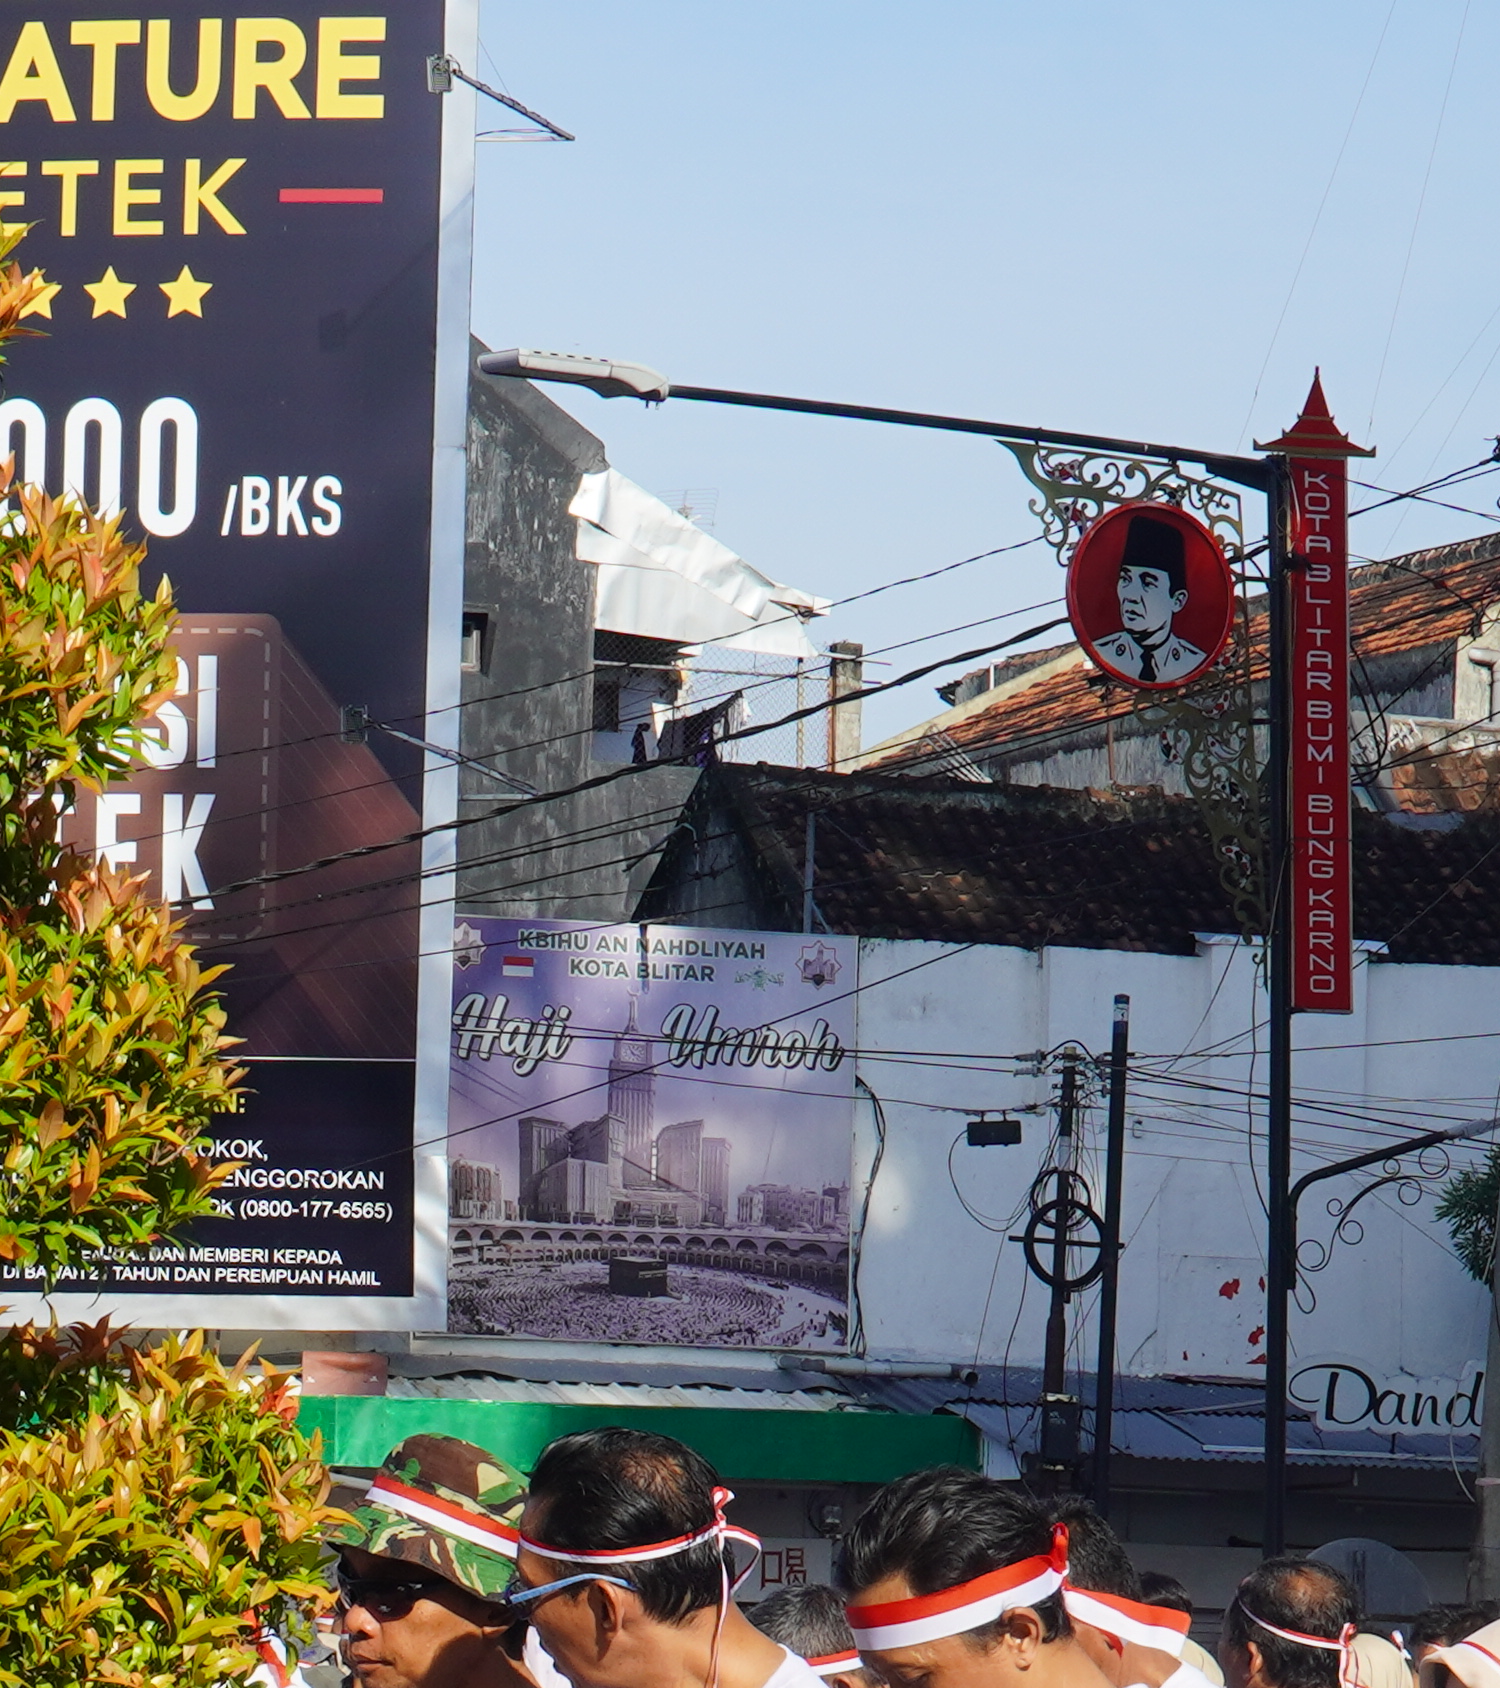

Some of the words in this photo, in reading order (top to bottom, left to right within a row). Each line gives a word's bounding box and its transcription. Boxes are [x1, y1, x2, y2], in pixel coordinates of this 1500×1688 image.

[220, 474, 343, 536] /BKS
[1304, 470, 1331, 553] KOTA
[1305, 564, 1332, 691] BLITAR
[1306, 700, 1333, 784] BUMI
[1307, 794, 1335, 879] BUNG
[518, 930, 589, 951] KBIHU
[596, 935, 628, 952] AN
[636, 937, 766, 960] NAHDLIYAH
[569, 956, 629, 979] KOTA
[636, 962, 716, 982] BLITAR
[1308, 888, 1336, 994] KARNO
[452, 992, 573, 1077] Haji
[660, 1003, 845, 1071] Umroh
[220, 1167, 385, 1189] ENGGOROKAN
[240, 1199, 393, 1223] (0800-177-6565)
[114, 1265, 170, 1282] TAHUN
[175, 1266, 210, 1282] DAN
[215, 1268, 324, 1285] PEREMPUAN
[328, 1269, 381, 1287] HAMIL
[190, 1247, 268, 1264] MEMBERI
[274, 1249, 343, 1266] KEPADA
